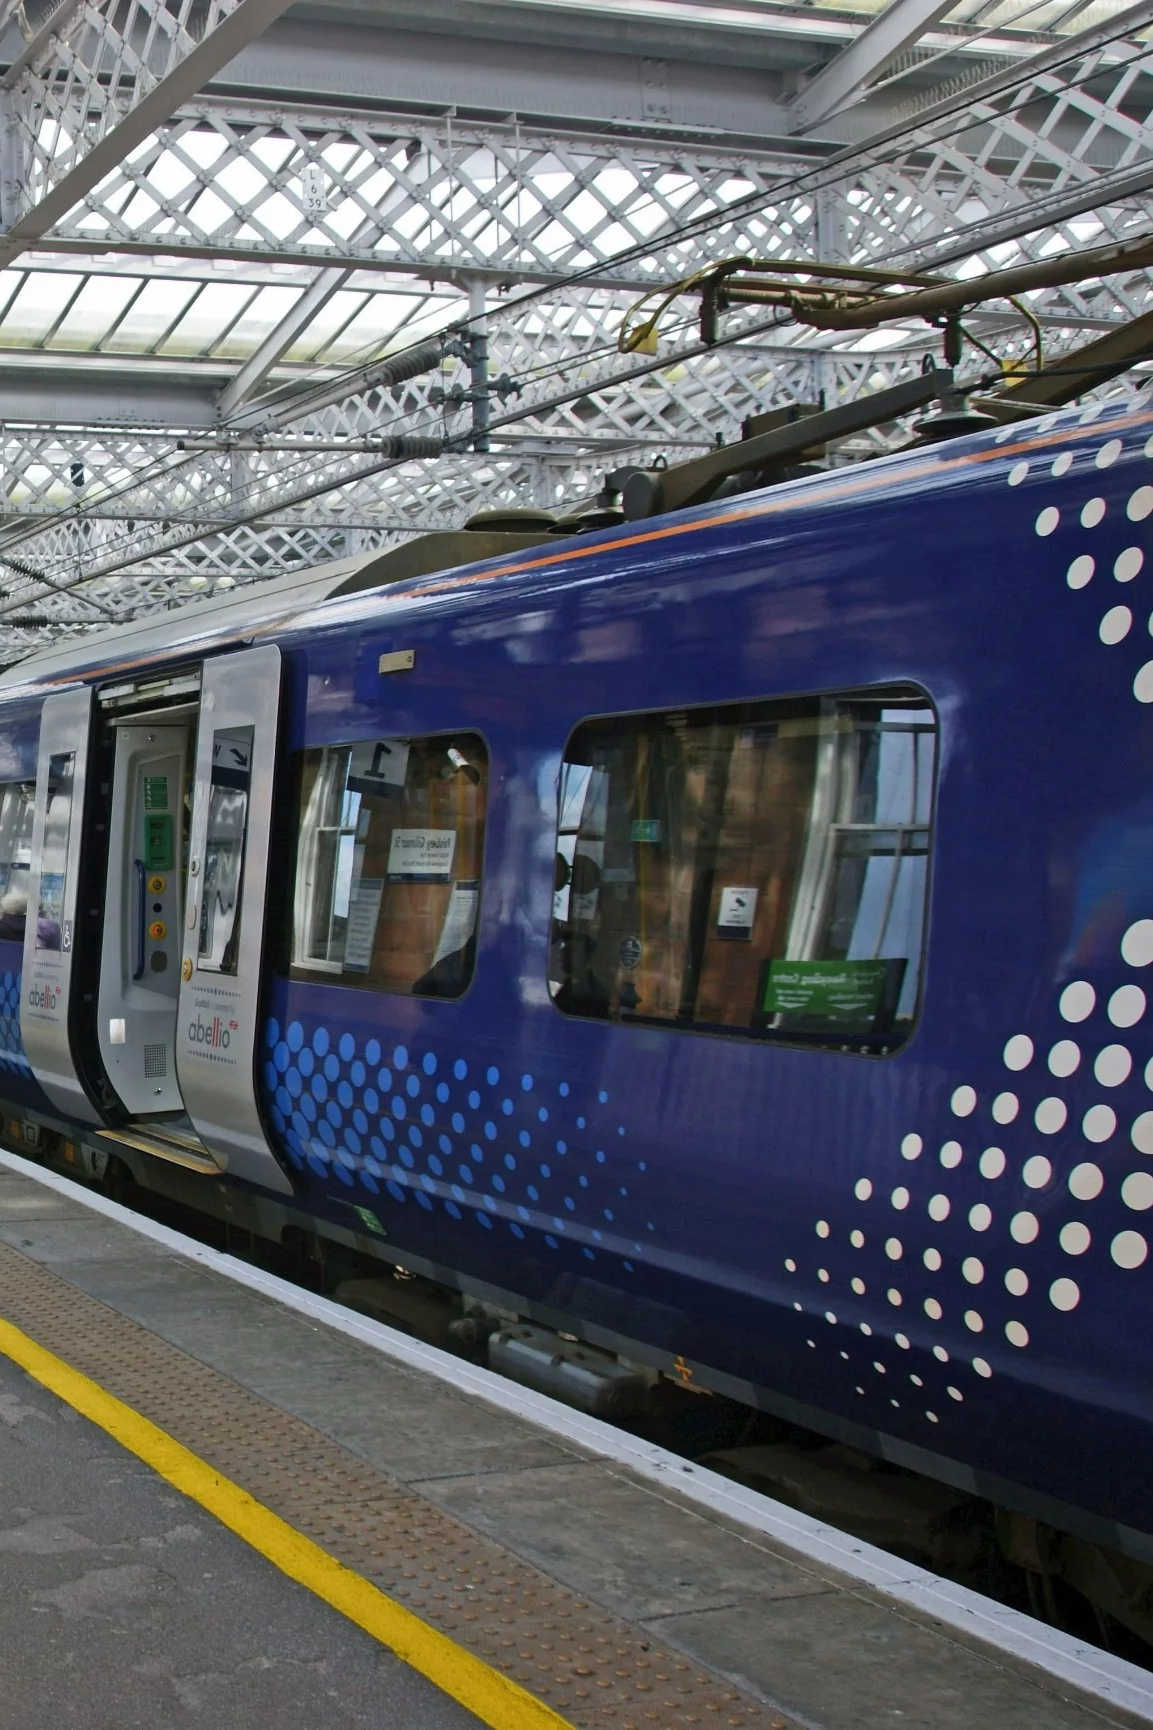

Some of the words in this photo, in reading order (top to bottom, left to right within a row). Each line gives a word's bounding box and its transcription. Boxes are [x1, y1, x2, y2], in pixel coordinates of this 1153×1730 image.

[310, 170, 315, 180] L
[311, 185, 318, 194] 6
[308, 199, 322, 208] 39
[28, 983, 57, 1010] abellio
[187, 1013, 231, 1049] abellio
